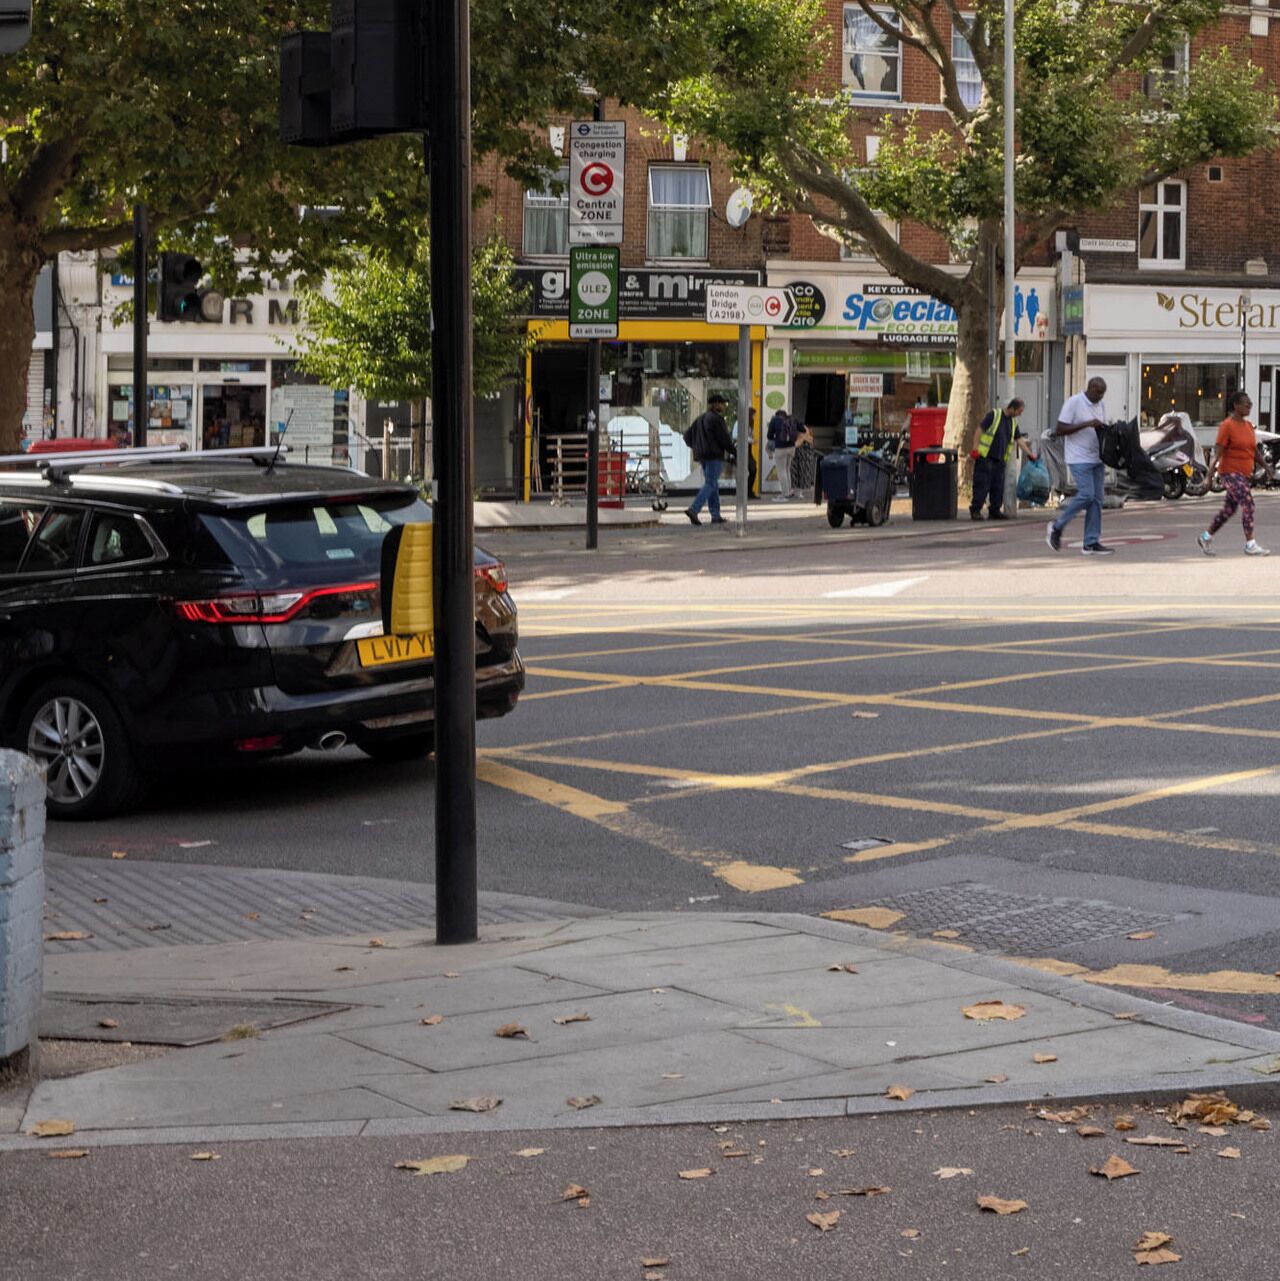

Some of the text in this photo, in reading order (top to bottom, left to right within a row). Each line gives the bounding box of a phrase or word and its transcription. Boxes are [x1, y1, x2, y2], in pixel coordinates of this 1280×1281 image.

[574, 141, 622, 150] Congestion
[579, 150, 616, 158] charging
[576, 200, 616, 209] Central
[580, 211, 612, 220] ZONE
[575, 252, 614, 260] Ultra low
[581, 284, 608, 293] ULEZ
[710, 289, 739, 298] London
[712, 300, 737, 309] Bridge
[578, 309, 609, 319] ZONE
[709, 311, 745, 320] (A2198)
[843, 294, 958, 330] Specia
[886, 323, 956, 332] ECO CLEA
